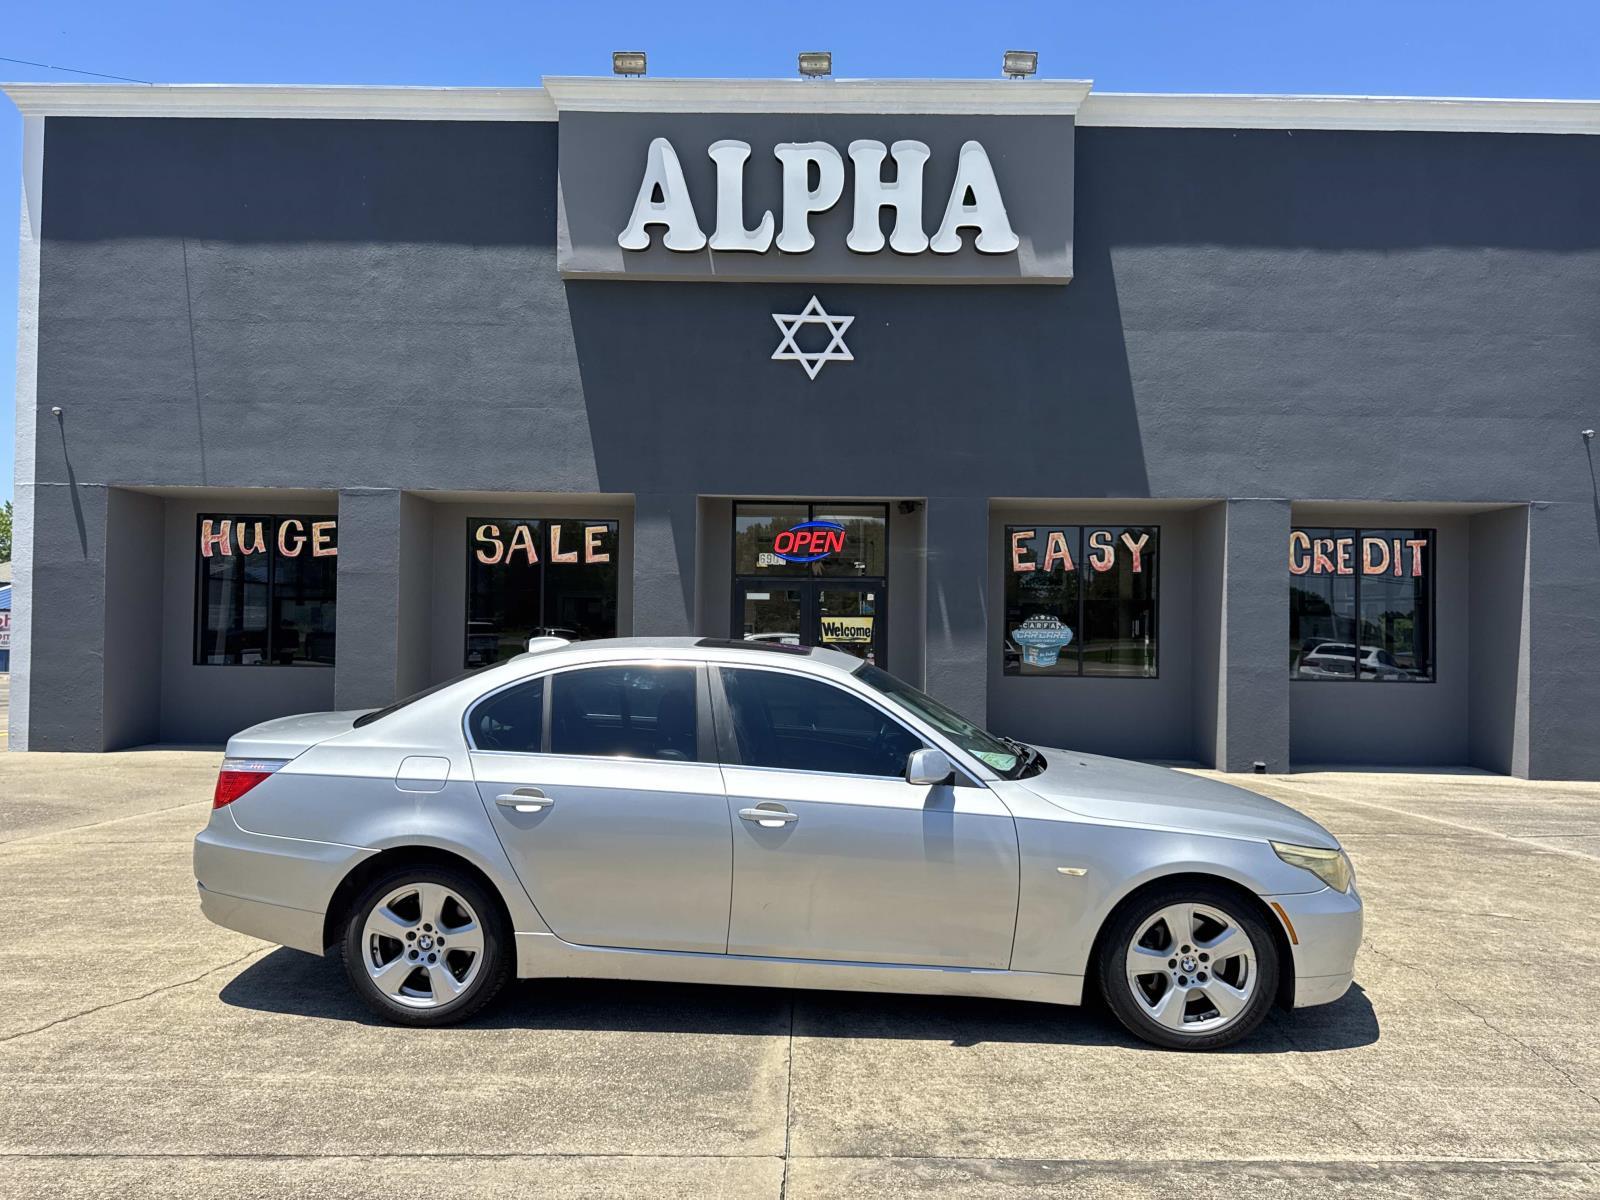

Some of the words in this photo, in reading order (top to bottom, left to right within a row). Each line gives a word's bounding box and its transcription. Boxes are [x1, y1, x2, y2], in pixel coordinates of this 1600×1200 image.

[618, 137, 1020, 254] ALPHA
[201, 520, 338, 557] HUGE
[475, 524, 610, 565] SALE
[773, 531, 847, 553] OPEN
[1012, 530, 1150, 573] EASY
[1289, 531, 1427, 577] CREDIT
[759, 553, 786, 566] 690
[821, 621, 872, 638] Welcome
